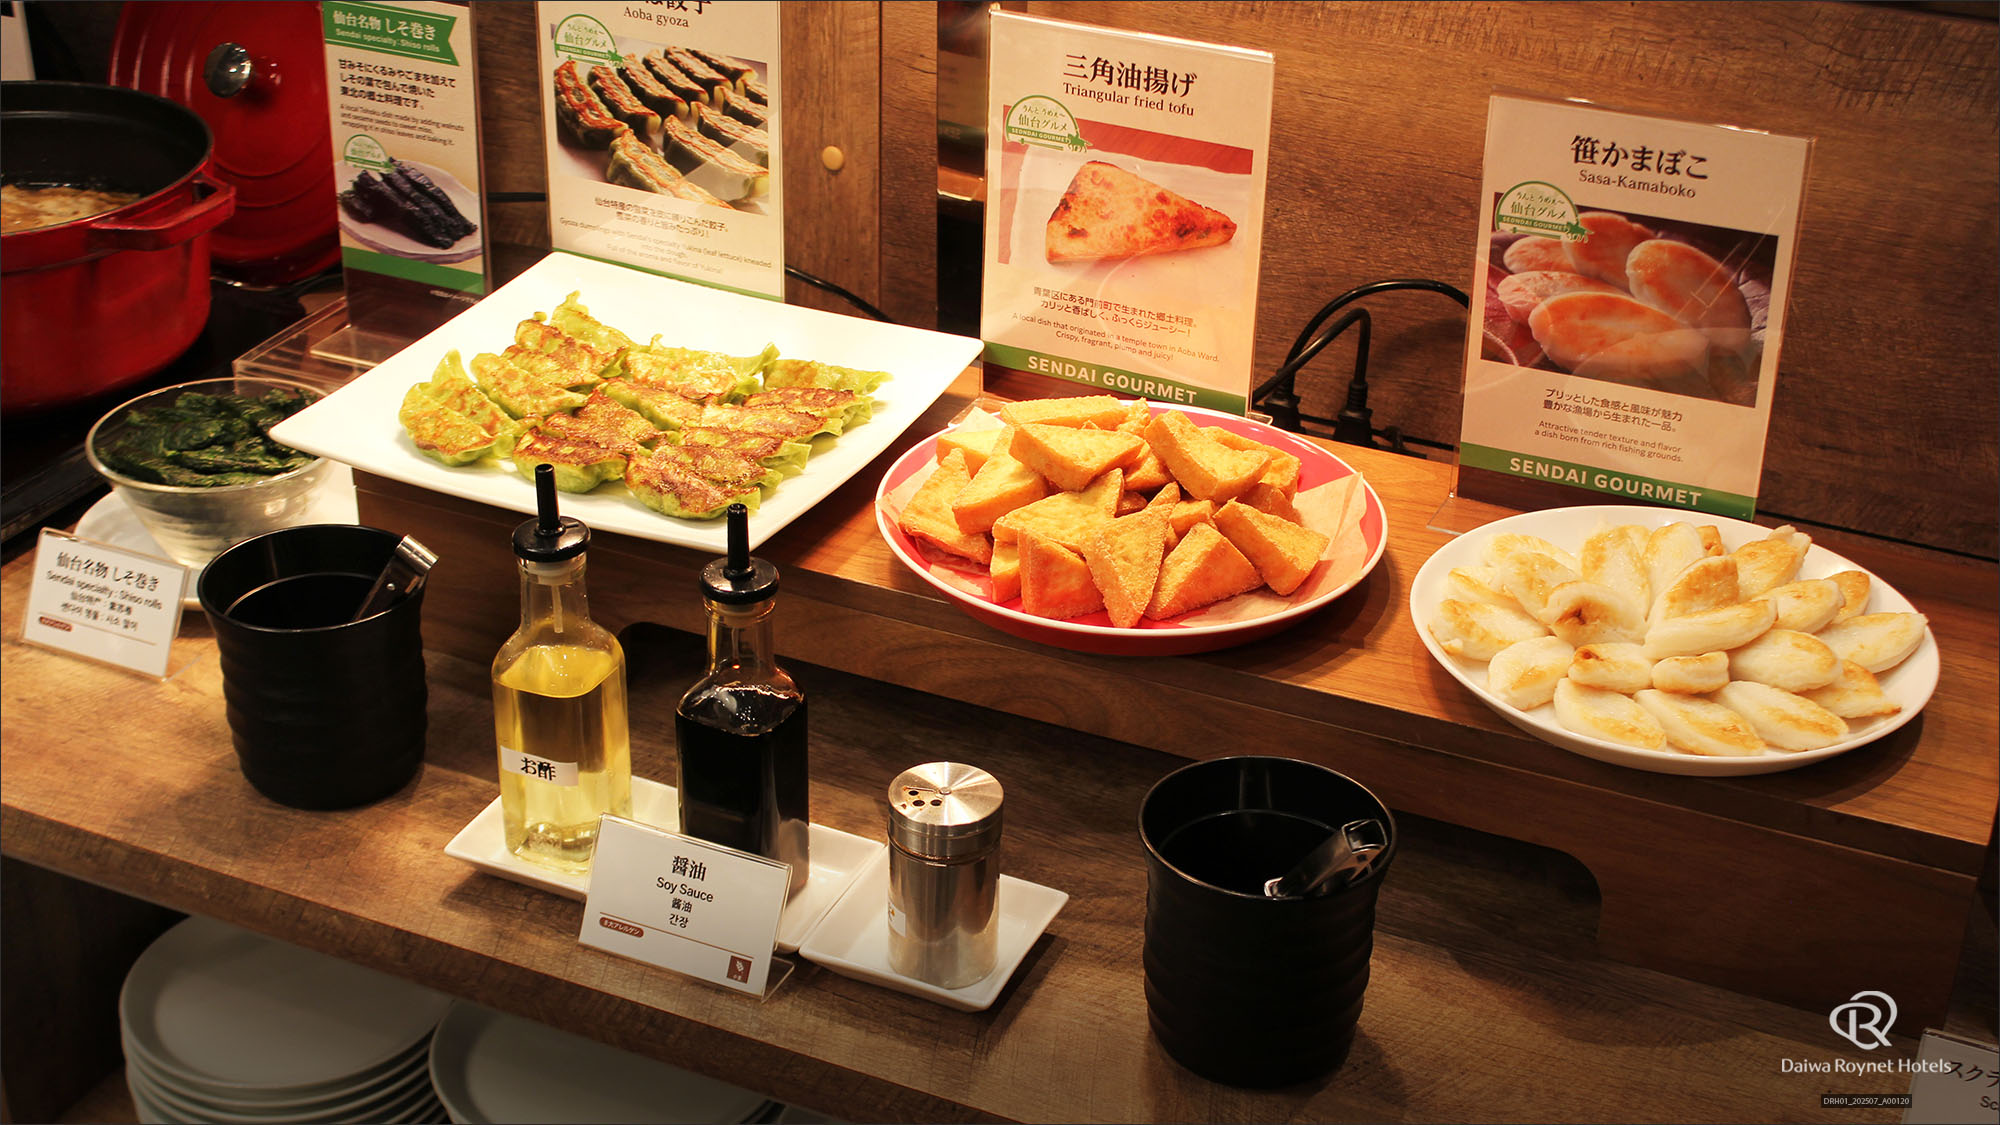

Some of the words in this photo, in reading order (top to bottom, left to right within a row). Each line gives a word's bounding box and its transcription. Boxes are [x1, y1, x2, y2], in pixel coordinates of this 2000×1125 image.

[332, 10, 381, 31] 仙台名物
[385, 18, 436, 41] しそ巻き
[623, 6, 652, 21] Aoba
[656, 14, 689, 28] gyoza
[564, 32, 607, 48] 仙台グルメ
[1063, 54, 1198, 98] 三角油揚げ
[1022, 104, 1040, 114] うんと
[1062, 82, 1130, 105] Triangular
[1134, 95, 1164, 112] fried
[1168, 101, 1194, 117] tofu
[1018, 113, 1068, 132] 仙台グルメ
[1570, 134, 1710, 180] 笹かまぼこ
[1578, 168, 1696, 199] Sasa-Kamaboko
[1510, 200, 1567, 220] 仙台グルメ
[1034, 286, 1197, 328] 青葉区にある門前町で生まれた郷土料理。
[1019, 314, 1036, 323] local
[1037, 318, 1052, 328] dish
[1053, 321, 1068, 330] that
[1070, 325, 1106, 338] originated
[1122, 335, 1148, 348] temple
[1148, 340, 1168, 350] town
[1168, 344, 1176, 352] in
[1178, 346, 1196, 358] Aoba
[1198, 350, 1220, 362] Ward.
[1056, 330, 1080, 343] Crispy,
[1081, 335, 1113, 349] fragrant,
[1114, 343, 1138, 354] plump
[1138, 348, 1153, 356] and
[1153, 350, 1174, 362] juicy!
[1028, 354, 1096, 382] SENDAI
[1103, 371, 1198, 404] GOURMET
[1543, 398, 1677, 433] 豊かな漁場から生まれた一品。
[1545, 388, 1684, 422] プリッとした食感と風味が魅力
[1538, 420, 1579, 434] Attractive
[1580, 427, 1608, 440] tender
[1609, 432, 1639, 446] texture
[1640, 438, 1656, 449] and
[1657, 441, 1682, 453] flavor
[1541, 429, 1558, 439] dish
[1560, 433, 1579, 444] born
[1580, 436, 1600, 447] from
[1602, 440, 1618, 450] rich
[1618, 442, 1646, 458] fishing
[1646, 450, 1684, 462] grounds.
[1510, 456, 1588, 484] SENDAI
[1594, 472, 1702, 507] GOURMET
[56, 551, 109, 579] 仙台名物
[112, 566, 160, 592] しそ巻き
[46, 570, 75, 586] Sendai
[76, 580, 114, 598] specialty
[120, 590, 143, 604] Shiso
[144, 598, 162, 610] rolls
[521, 756, 556, 781] お酢
[672, 856, 707, 882] 醤油
[656, 876, 678, 894] Soy
[679, 884, 714, 902] Sauce
[669, 913, 689, 929] 간장
